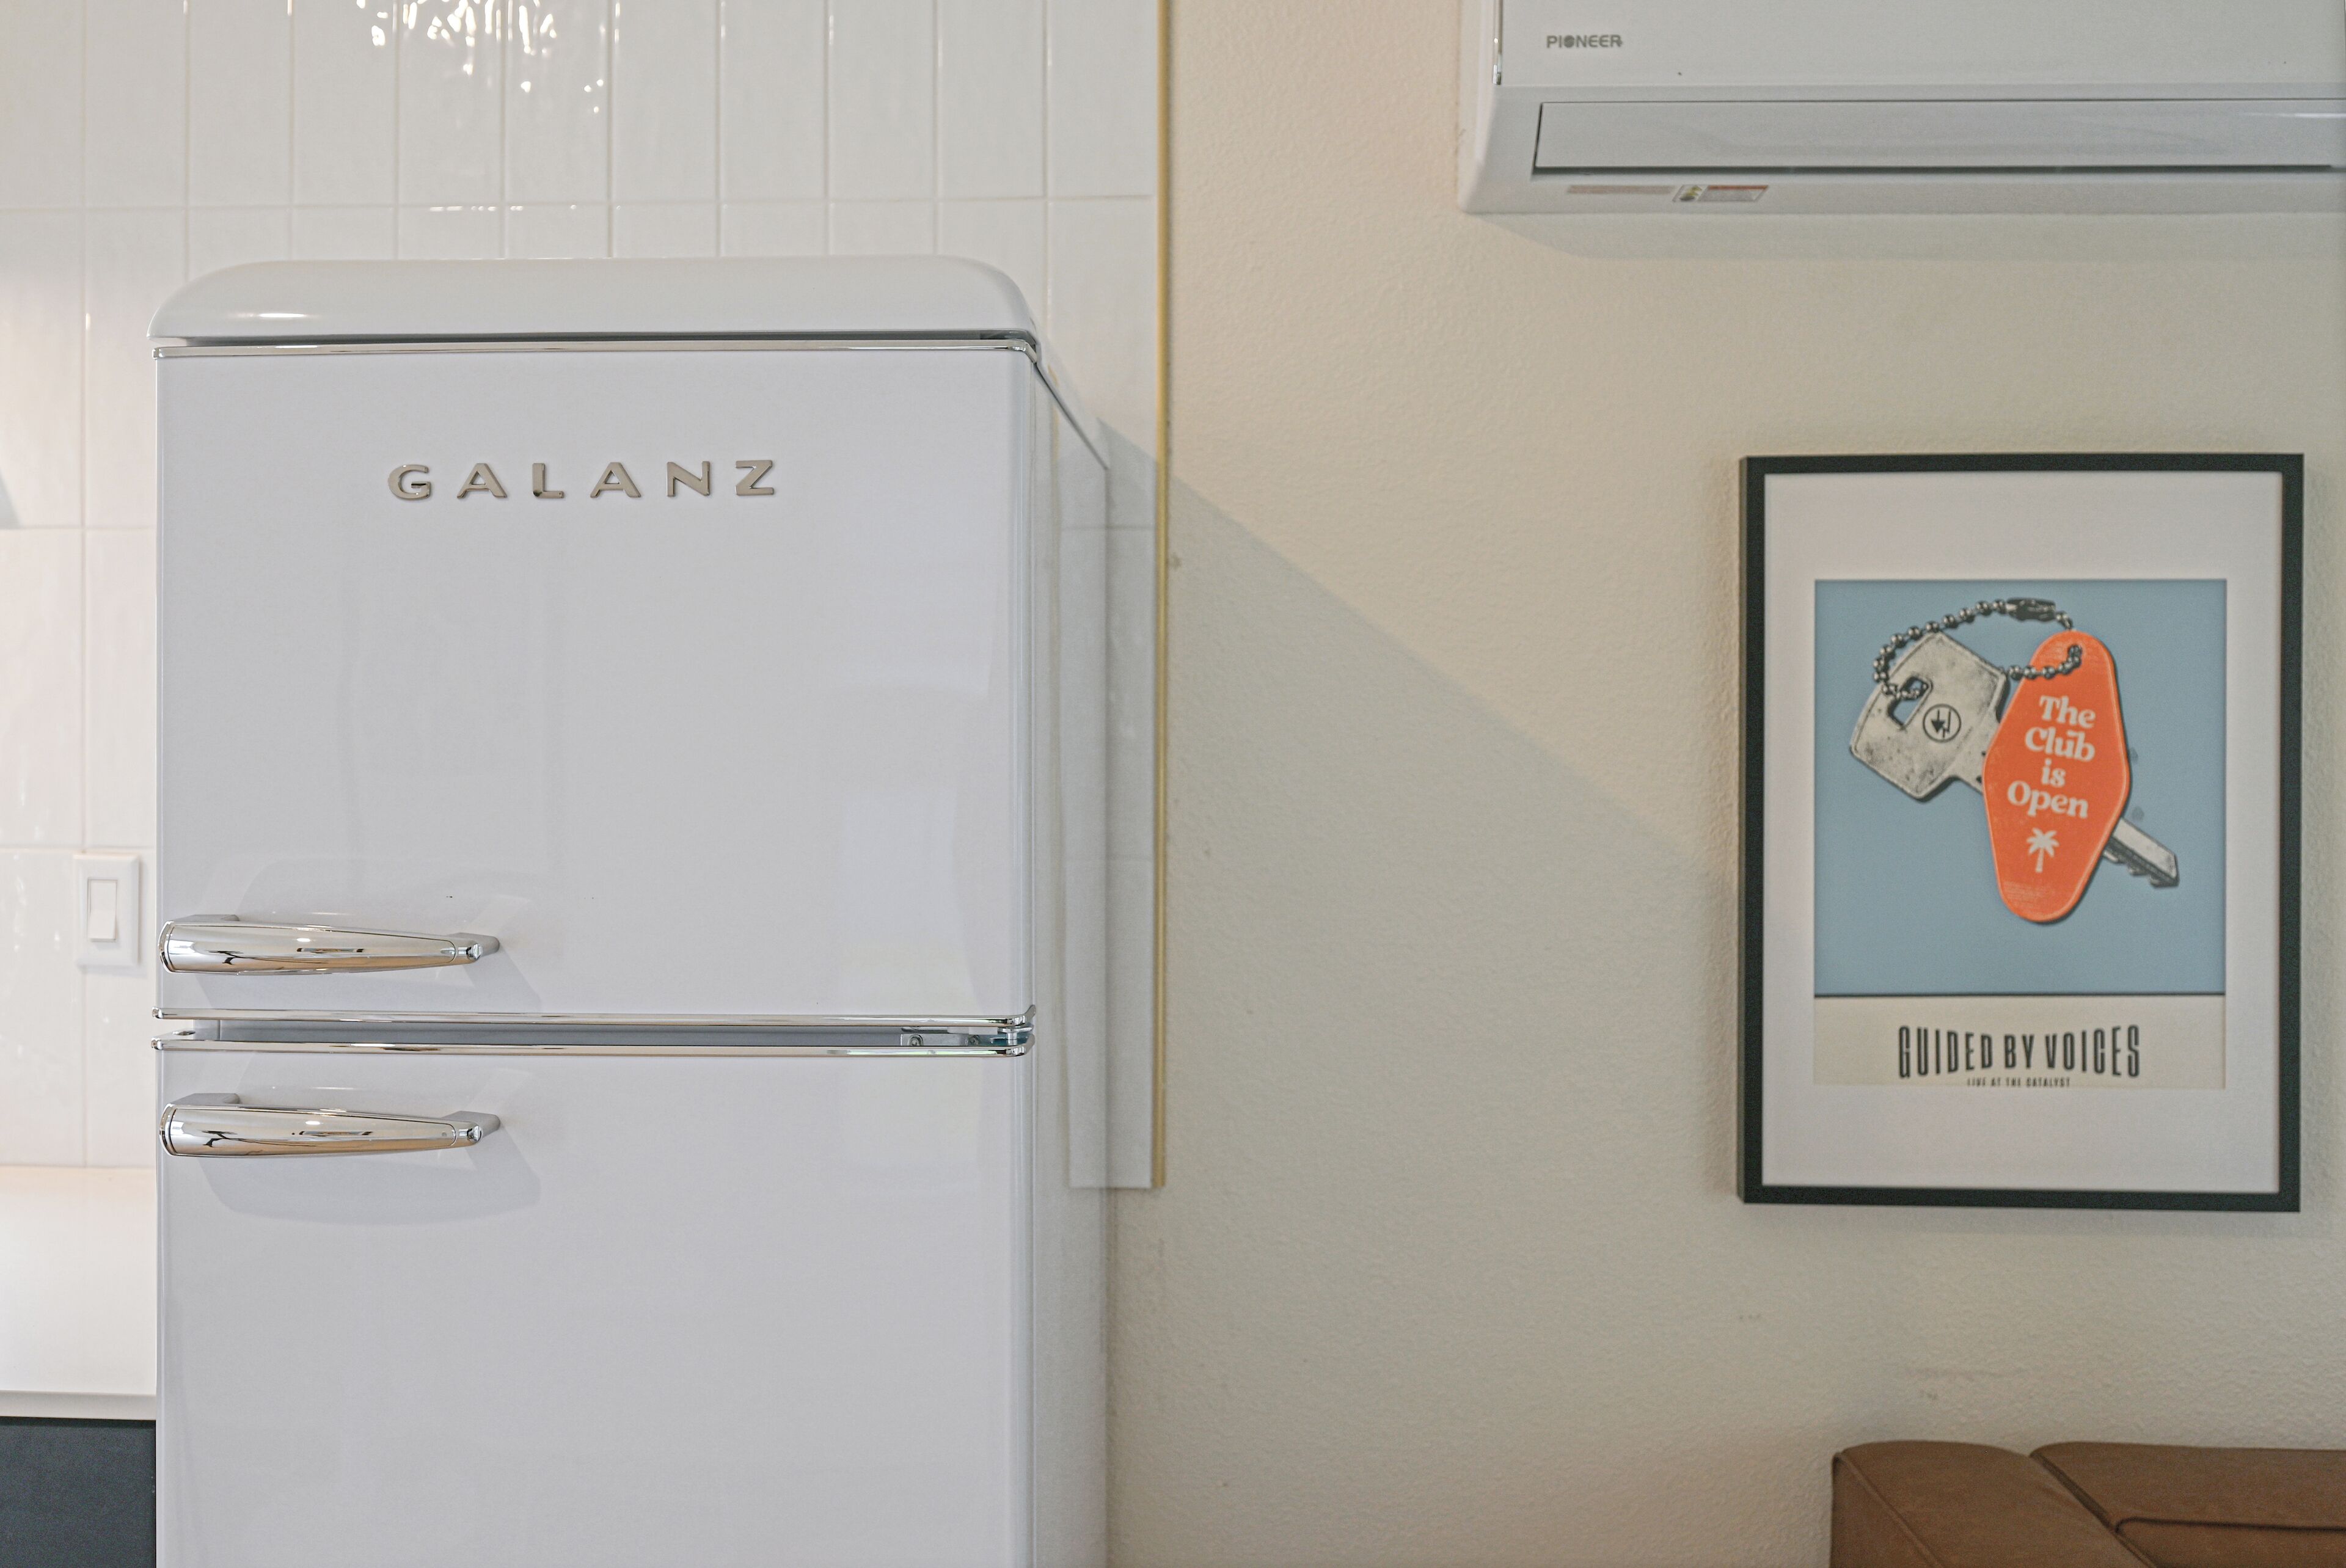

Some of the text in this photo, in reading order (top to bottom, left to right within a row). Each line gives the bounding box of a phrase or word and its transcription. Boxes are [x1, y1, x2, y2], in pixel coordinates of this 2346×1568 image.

[1546, 34, 1623, 48] PIONEER
[388, 460, 775, 499] GALANZ
[2039, 695, 2096, 729] The
[2025, 726, 2096, 762] Club
[2041, 758, 2066, 787] is
[2007, 780, 2089, 819] Open
[1899, 1024, 2140, 1079] GUIDED BY VOICES
[1990, 1077, 2001, 1087] AT
[2006, 1077, 2022, 1087] THE
